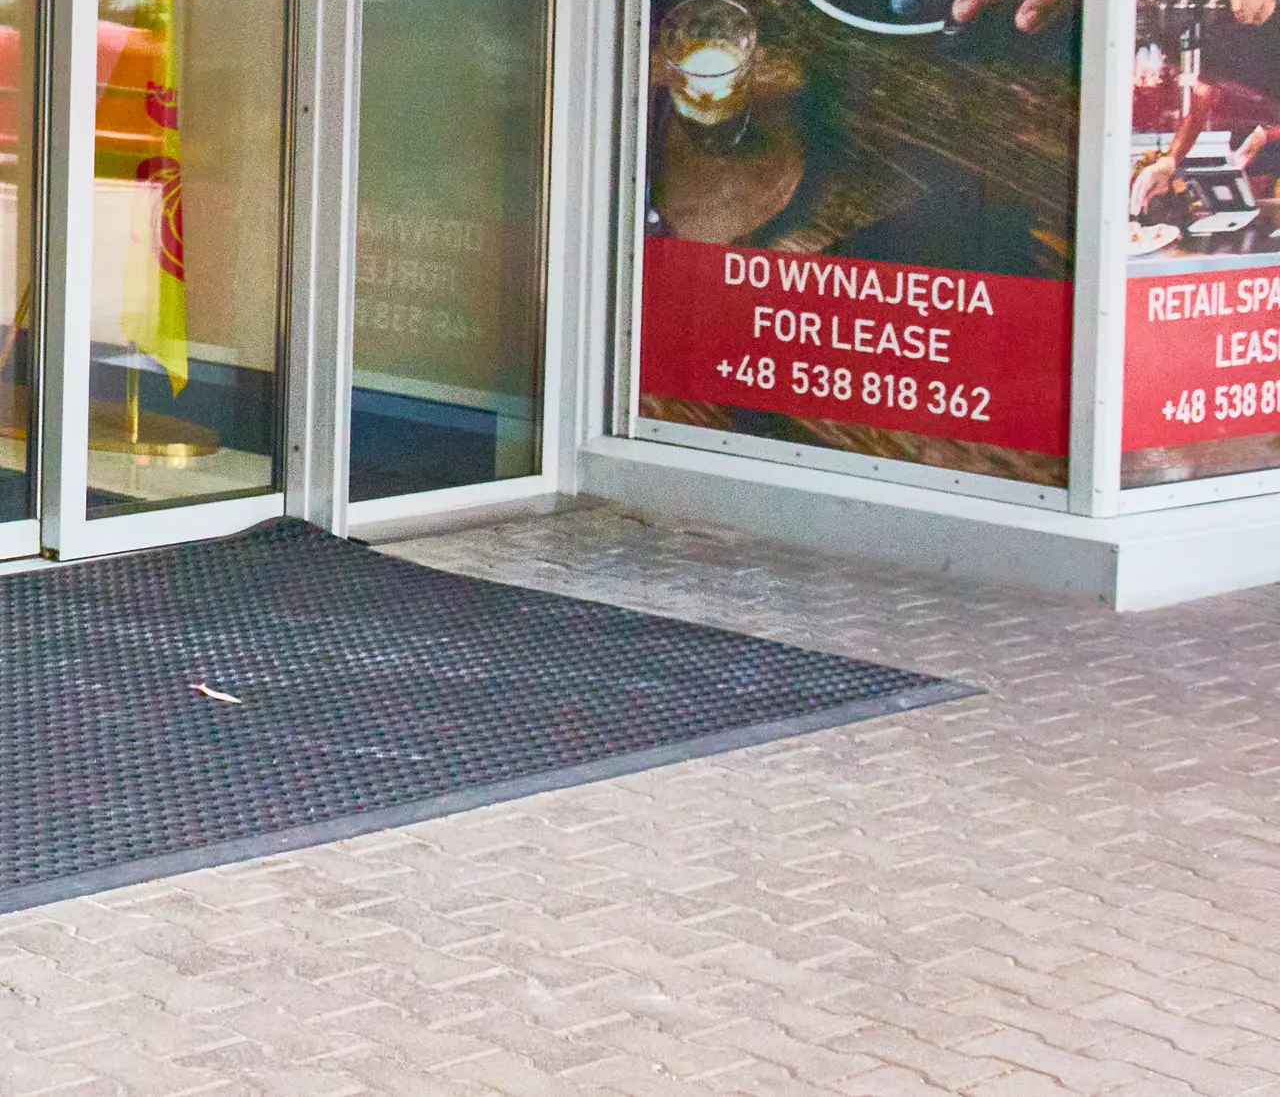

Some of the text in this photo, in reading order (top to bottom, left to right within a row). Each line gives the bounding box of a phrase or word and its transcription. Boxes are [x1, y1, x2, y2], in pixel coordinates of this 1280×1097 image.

[724, 252, 994, 317] DO WYNAJĘCIA
[1148, 281, 1234, 323] RETAIL
[753, 306, 952, 364] FOR LEASE
[1215, 327, 1280, 368] LEAS
[716, 354, 991, 422] +48 538 818 362
[1161, 387, 1206, 425] +48
[1214, 381, 1257, 421] 538
